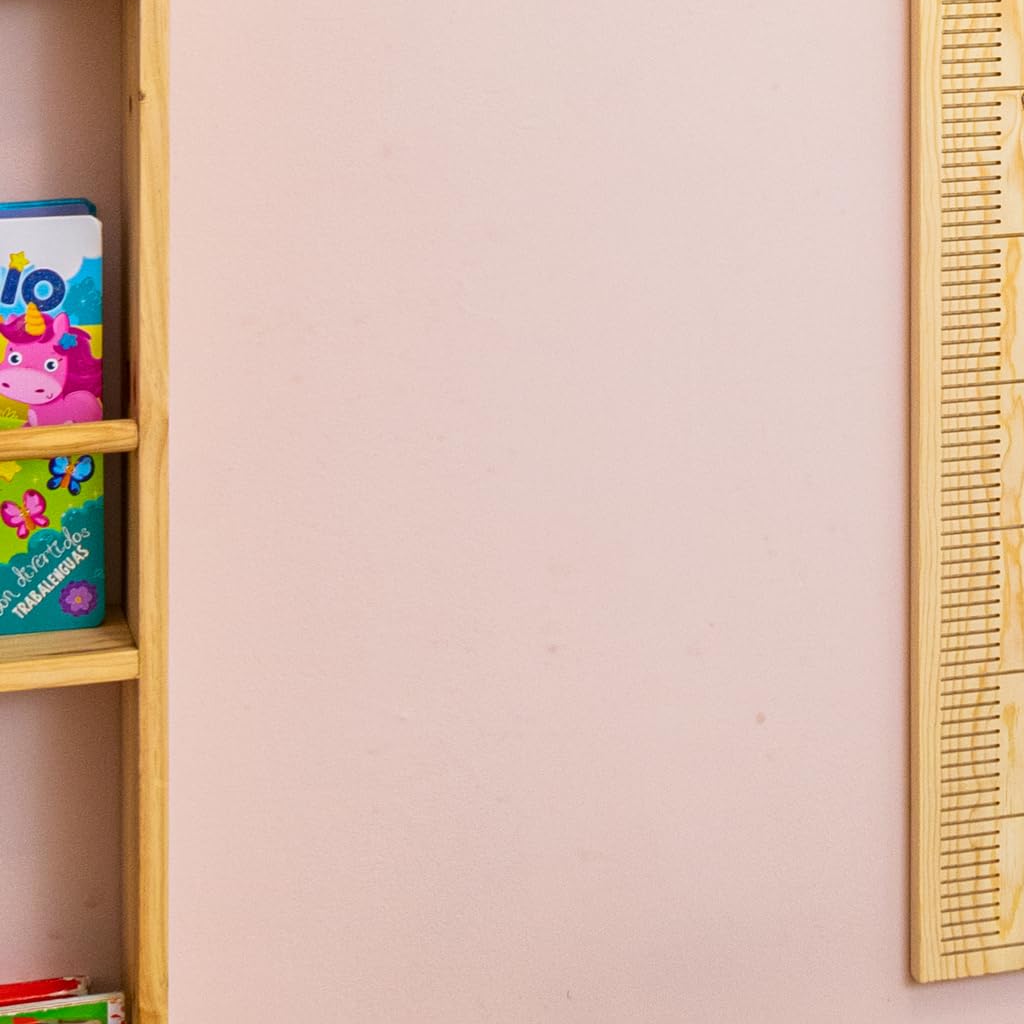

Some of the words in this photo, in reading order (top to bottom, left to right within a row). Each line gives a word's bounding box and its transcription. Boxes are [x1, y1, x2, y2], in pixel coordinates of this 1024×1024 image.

[0, 589, 21, 616] on
[11, 526, 91, 588] divertidos
[11, 544, 90, 619] TRABALENGUAS
